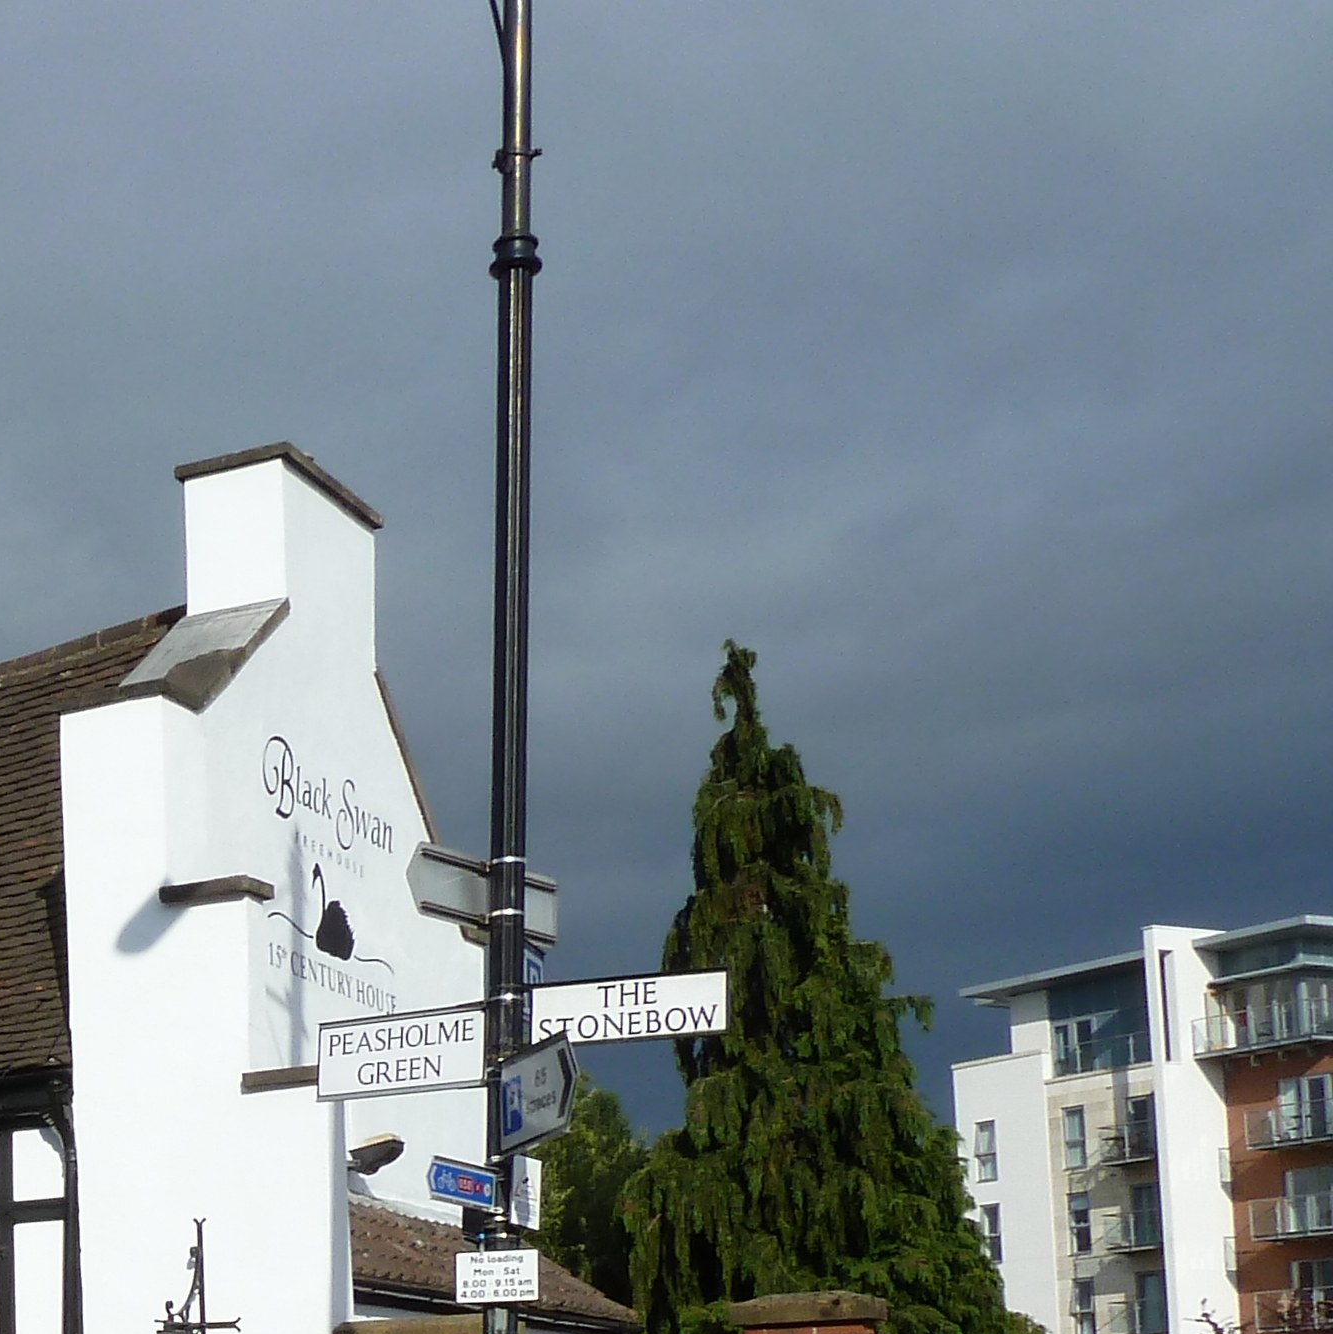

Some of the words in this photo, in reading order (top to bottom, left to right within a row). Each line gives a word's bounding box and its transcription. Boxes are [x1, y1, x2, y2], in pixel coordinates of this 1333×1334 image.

[263, 735, 332, 820] Black
[336, 779, 393, 854] Swan
[290, 950, 353, 999] CENTURY
[355, 978, 396, 1017] HOUSE
[597, 981, 657, 1008] THE
[328, 1018, 475, 1057] PEASHOLME
[539, 1004, 718, 1042] STONEBOW
[357, 1055, 442, 1086] GREEN
[506, 1083, 521, 1131] P
[471, 1255, 484, 1264] No
[487, 1254, 523, 1263] loading
[503, 1267, 520, 1275] Sat
[461, 1290, 485, 1298] 4.00
[520, 1289, 535, 1297] pm
[463, 1280, 486, 1288] 8.00
[495, 1278, 515, 1287] 9.15
